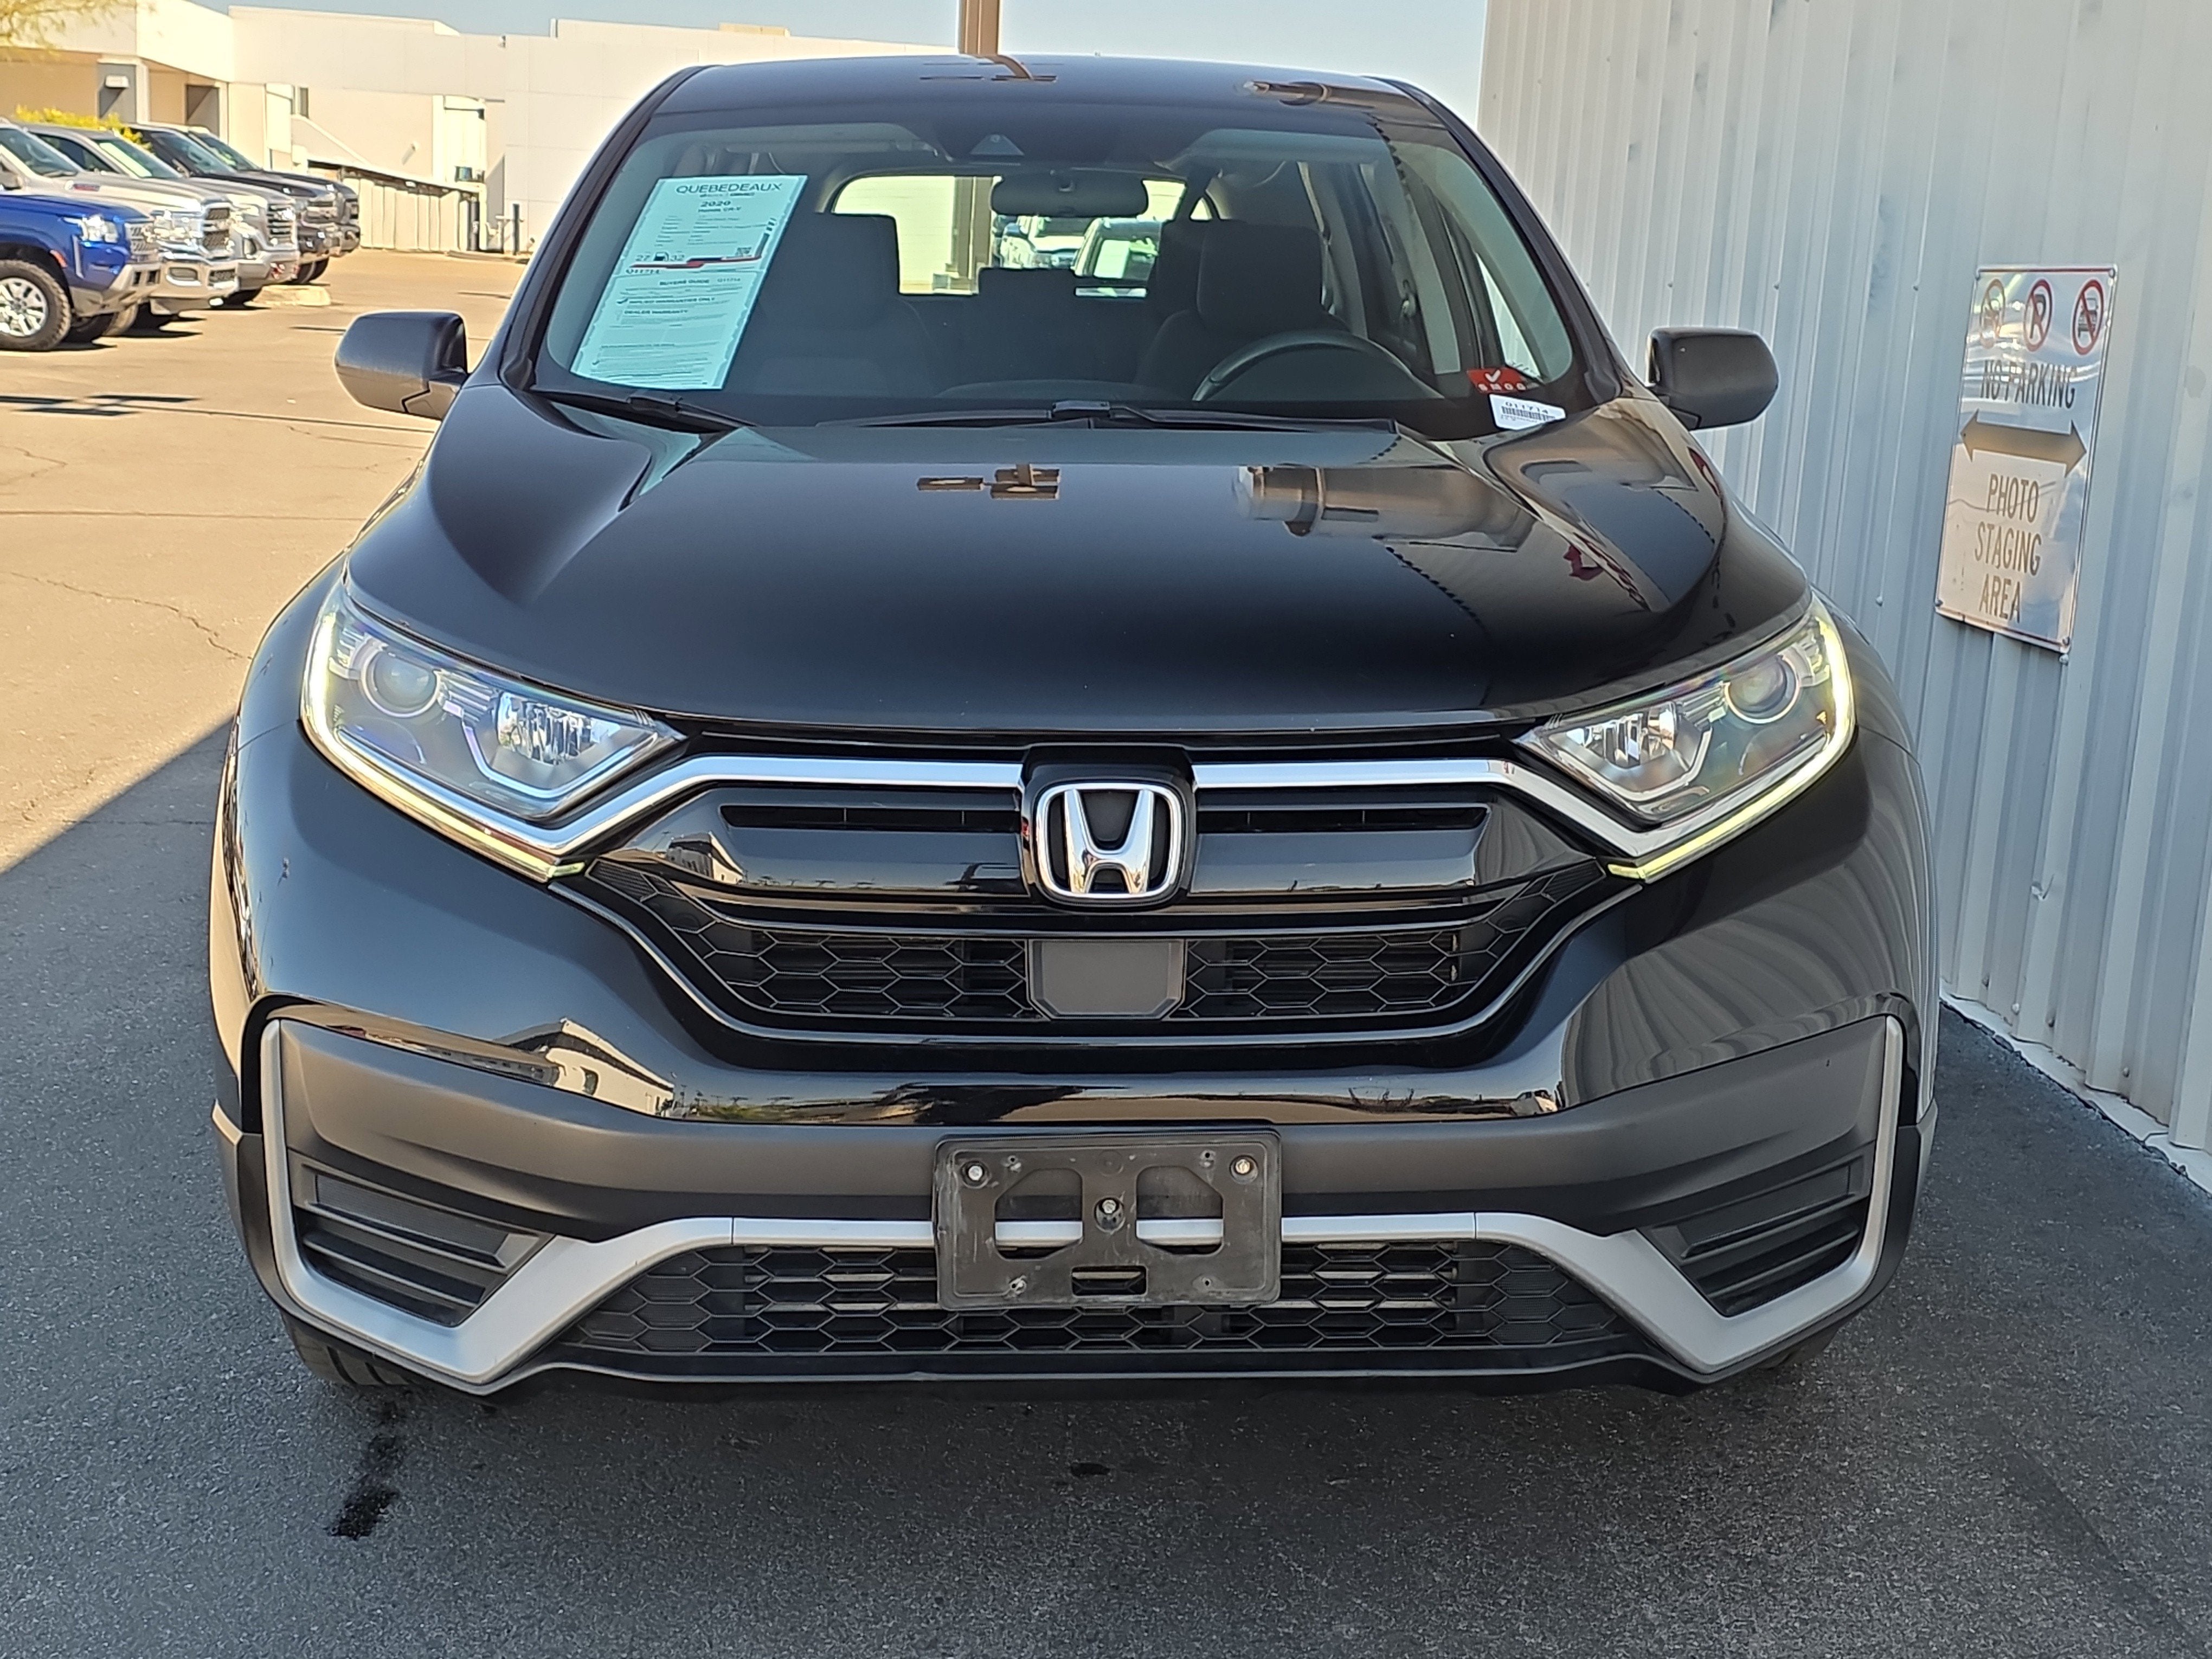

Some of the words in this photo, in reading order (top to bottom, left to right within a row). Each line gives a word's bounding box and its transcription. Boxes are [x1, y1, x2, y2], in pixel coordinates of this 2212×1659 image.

[676, 183, 782, 194] QUEBEDEAUX
[1980, 360, 2003, 400] NO
[2004, 361, 2078, 409] PARKING
[1986, 473, 2040, 523] PHOTO
[1975, 522, 2042, 576] STAGING
[1979, 574, 2021, 623] AREA
